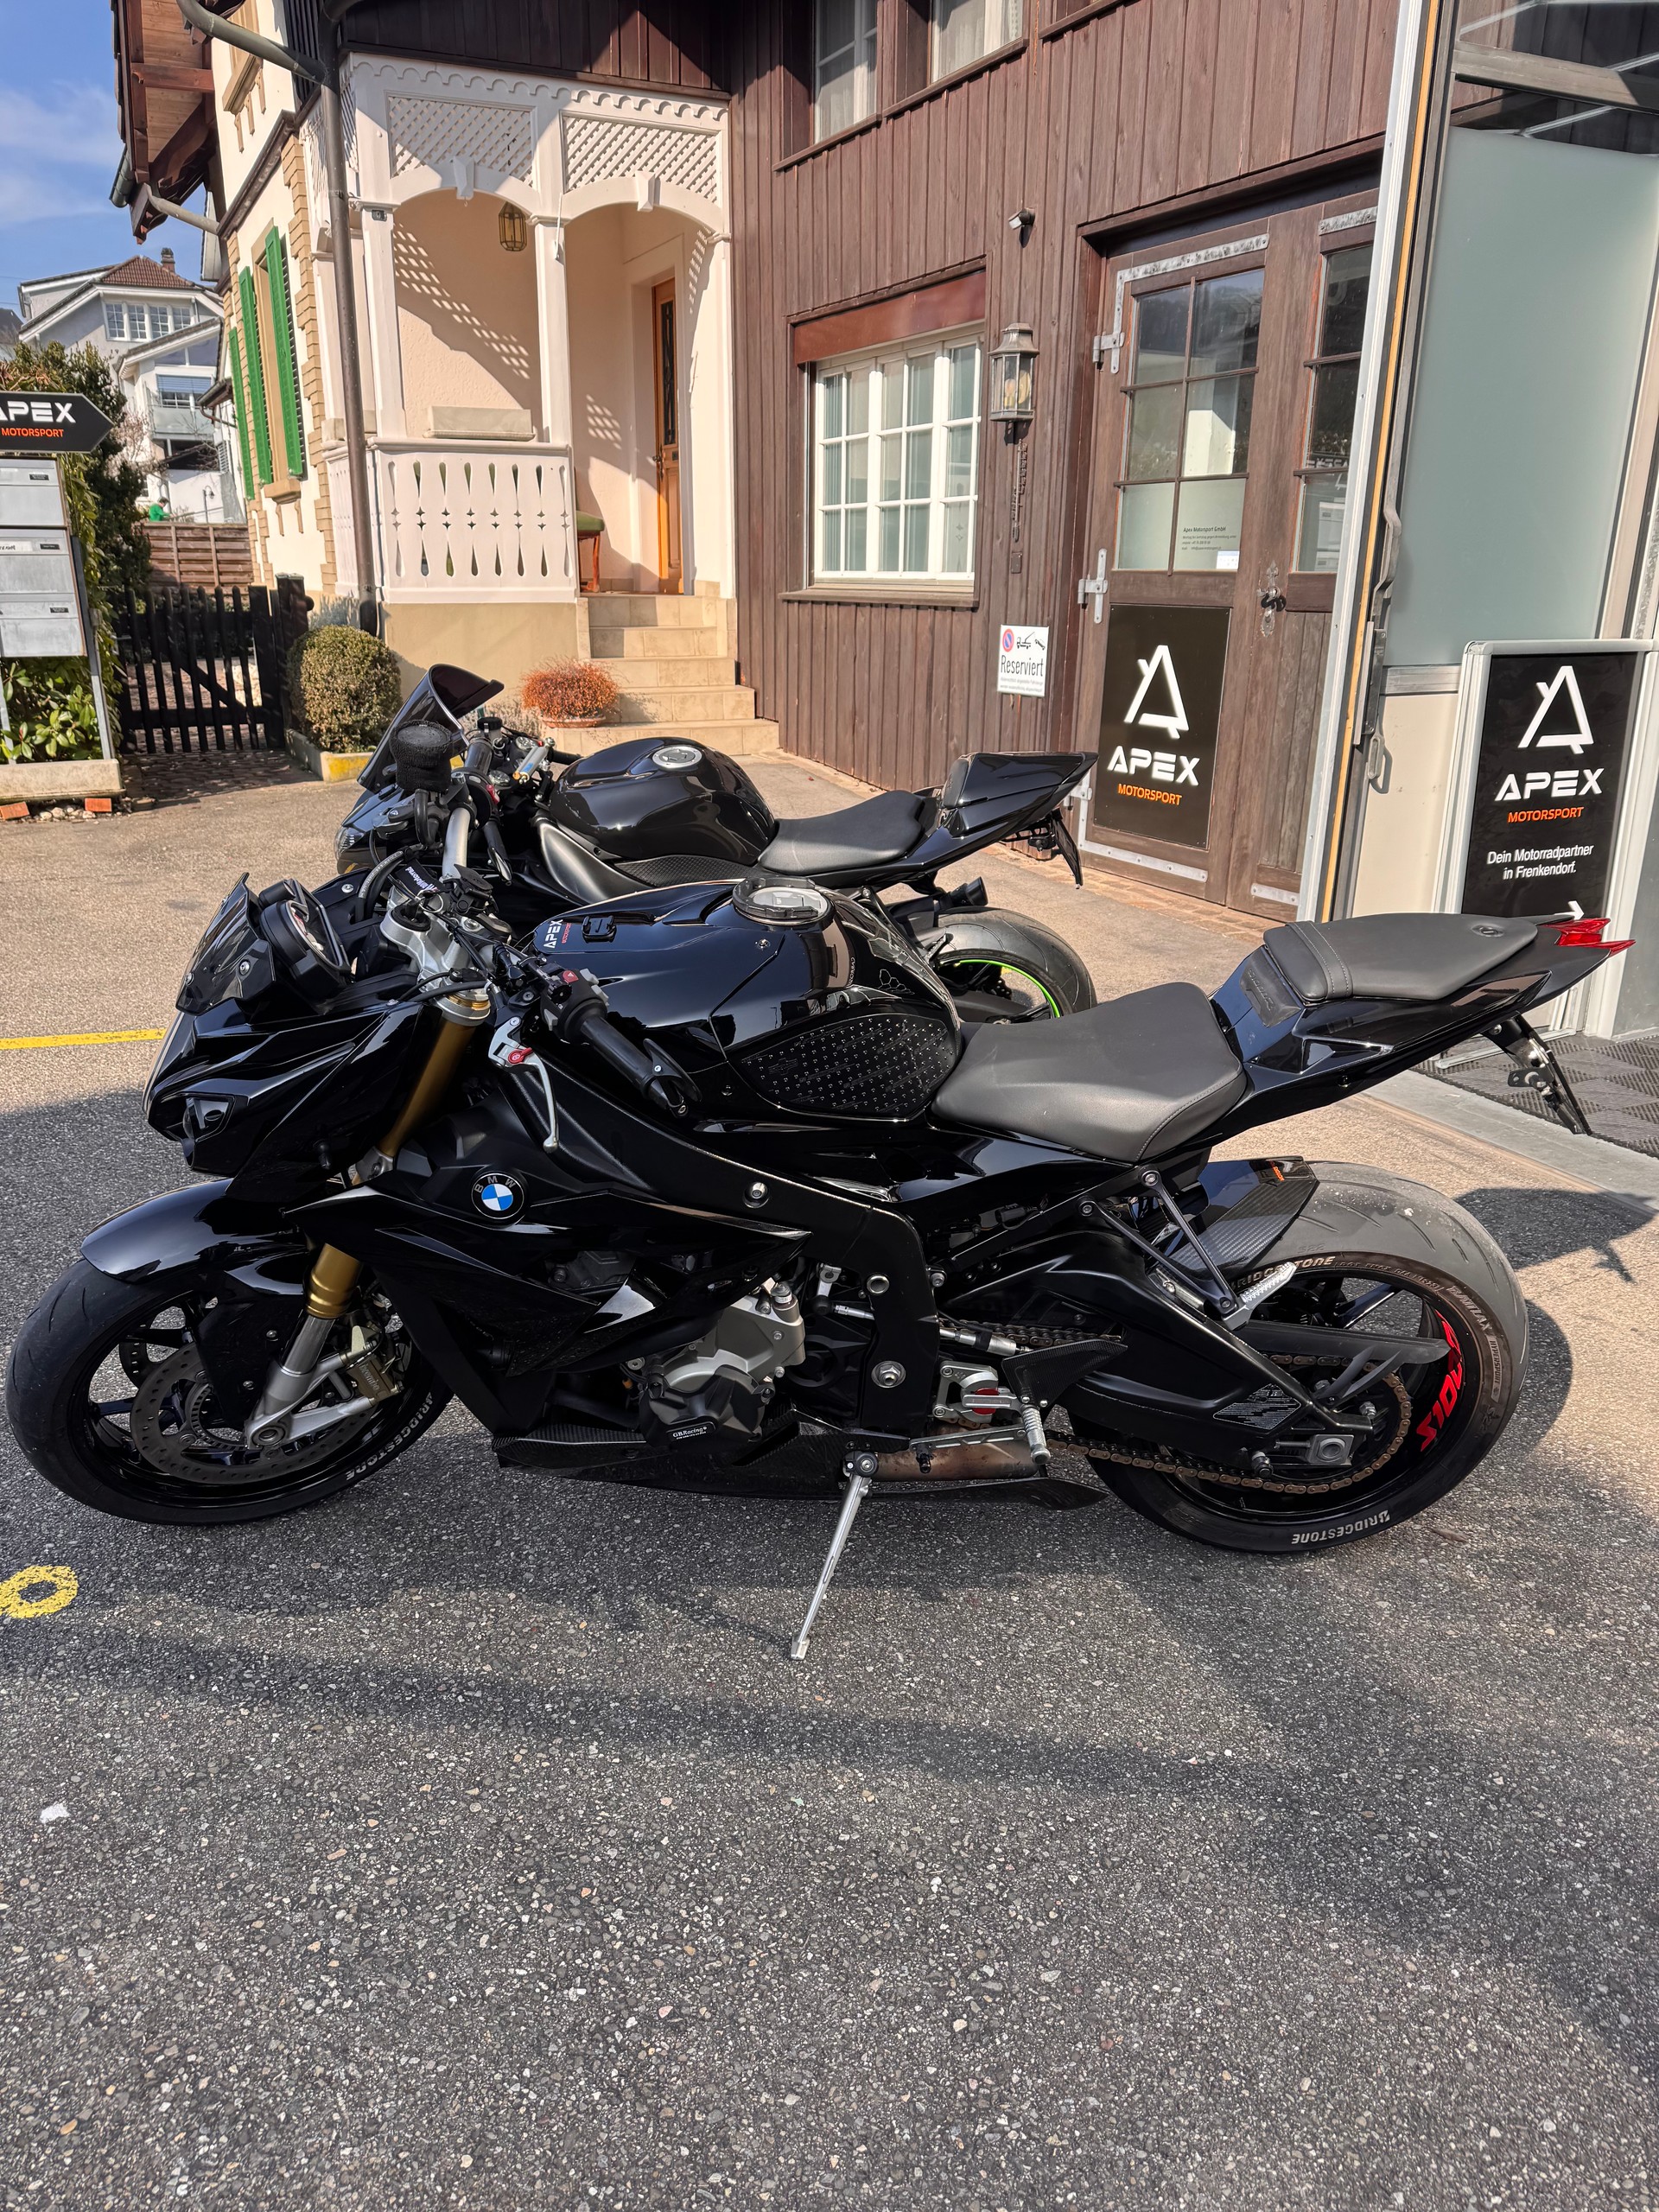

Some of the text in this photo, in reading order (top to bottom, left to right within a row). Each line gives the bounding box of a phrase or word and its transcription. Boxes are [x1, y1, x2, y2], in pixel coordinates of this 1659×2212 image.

[1, 428, 64, 437] MOTORSPORT
[1001, 654, 1044, 677] Reserviert
[1107, 746, 1200, 786] APEX
[1117, 783, 1182, 805] MOTORSPORT
[1494, 768, 1605, 801] APEX
[1507, 807, 1584, 823] MOTORSPORT
[1487, 845, 1595, 865] Dein Motorradpartner
[1503, 861, 1577, 880] in Frenkendorf.
[543, 919, 563, 949] APEX
[474, 1175, 516, 1193] BMW
[1230, 1255, 1336, 1289] RIDGTONE
[1490, 1340, 1503, 1383] HYPERSPORT
[1291, 1510, 1390, 1545] BRIDGESTONE
